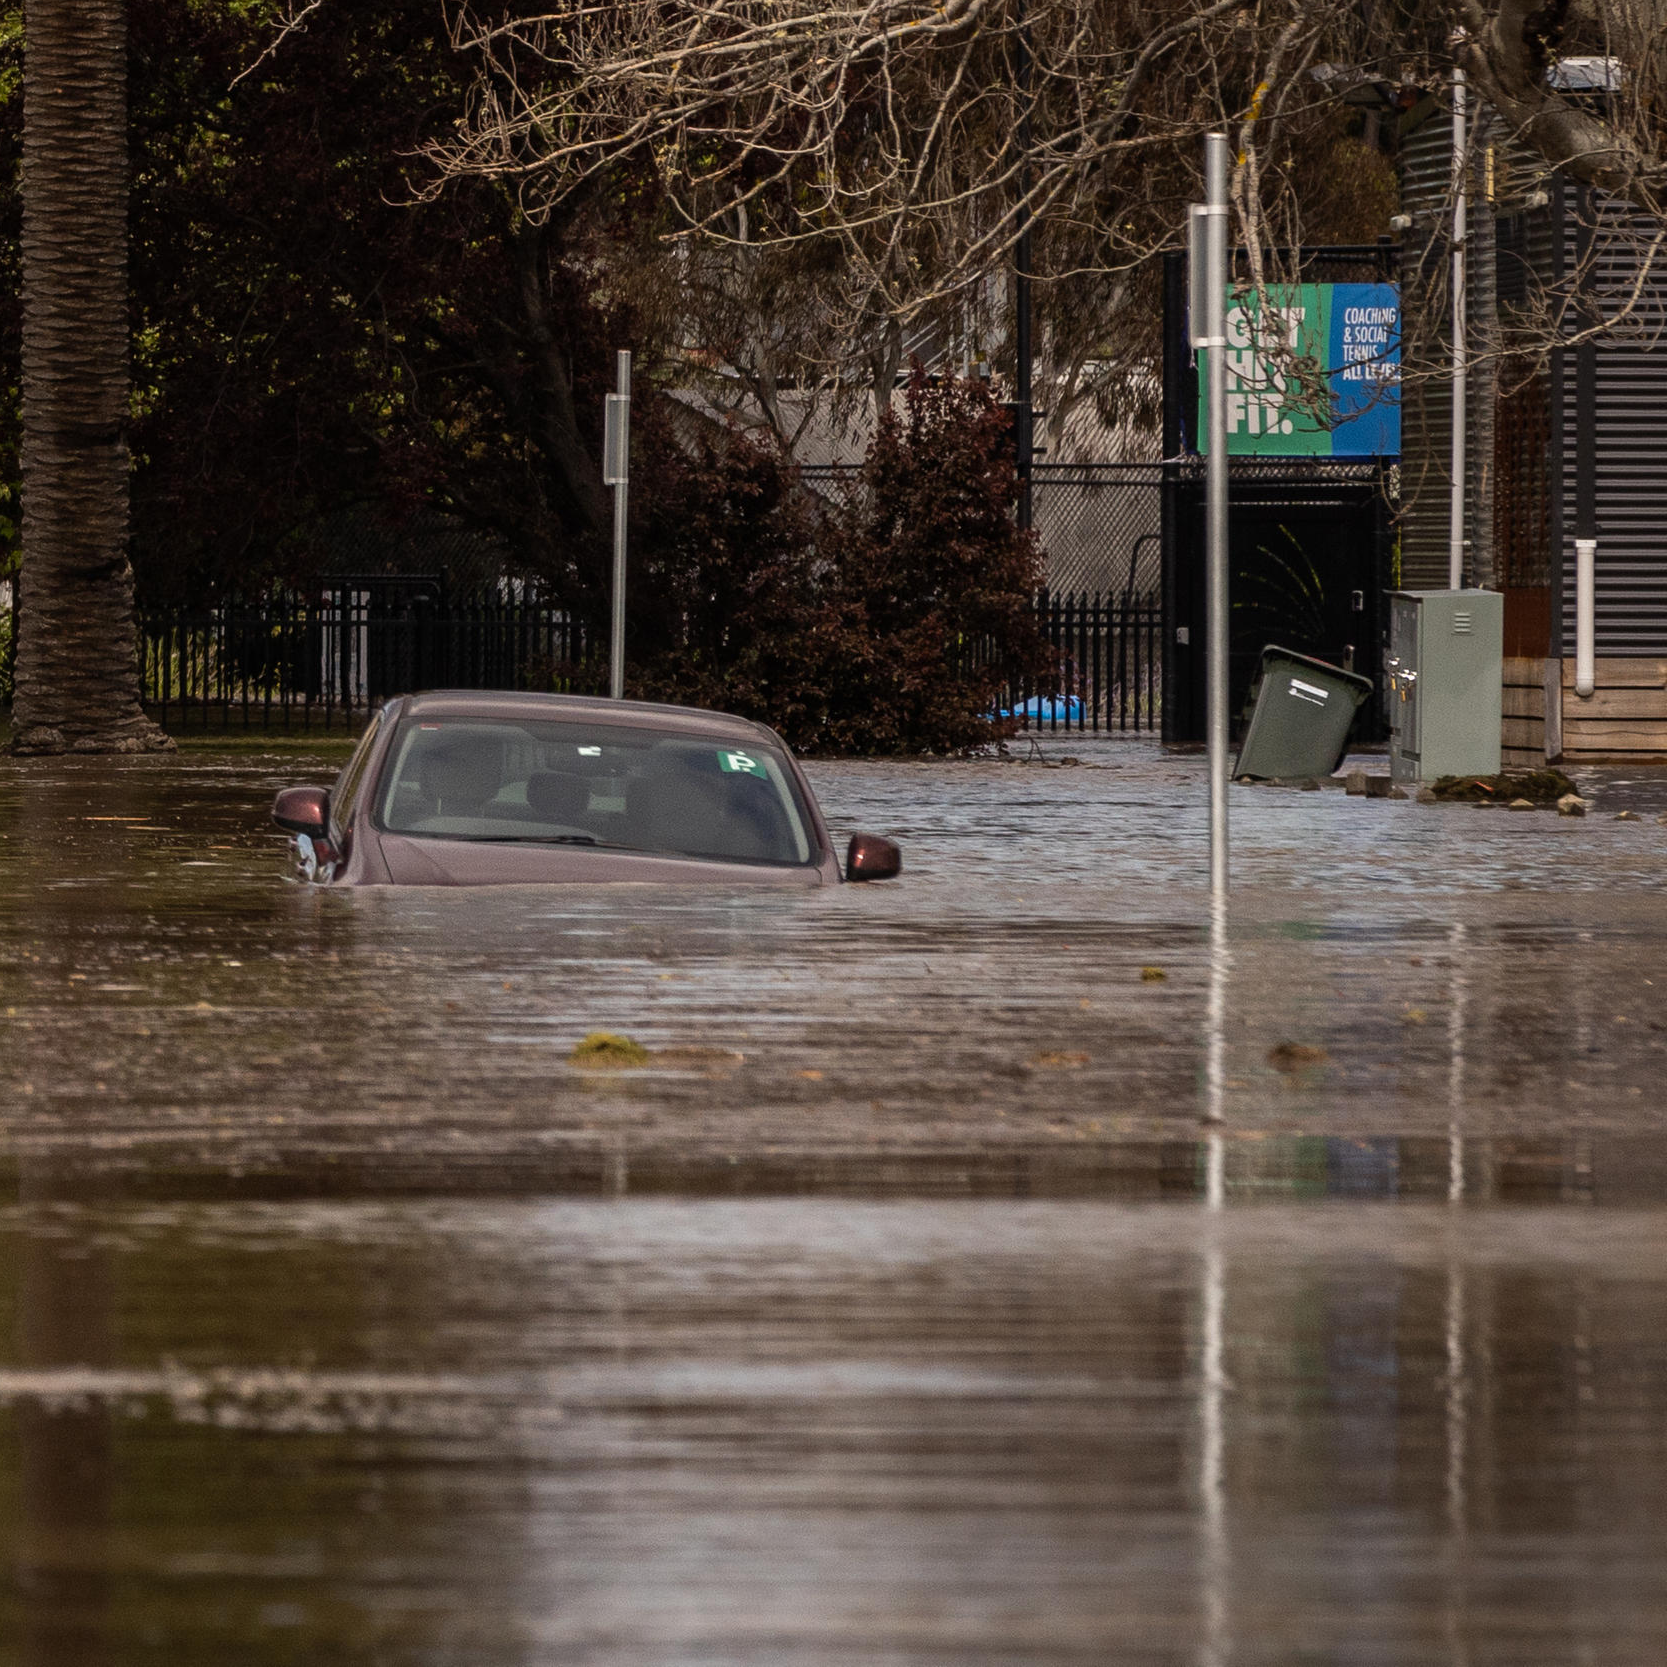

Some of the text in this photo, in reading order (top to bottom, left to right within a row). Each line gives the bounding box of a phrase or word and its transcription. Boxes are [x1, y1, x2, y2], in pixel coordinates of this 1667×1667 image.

[1345, 307, 1397, 325] COACHING
[1226, 307, 1306, 348] GET
[1343, 326, 1388, 343] & SOCIAL
[1342, 344, 1379, 362] TENNIS
[1342, 363, 1363, 380] ALL
[1226, 393, 1293, 435] FIT.
[727, 753, 757, 771] P
